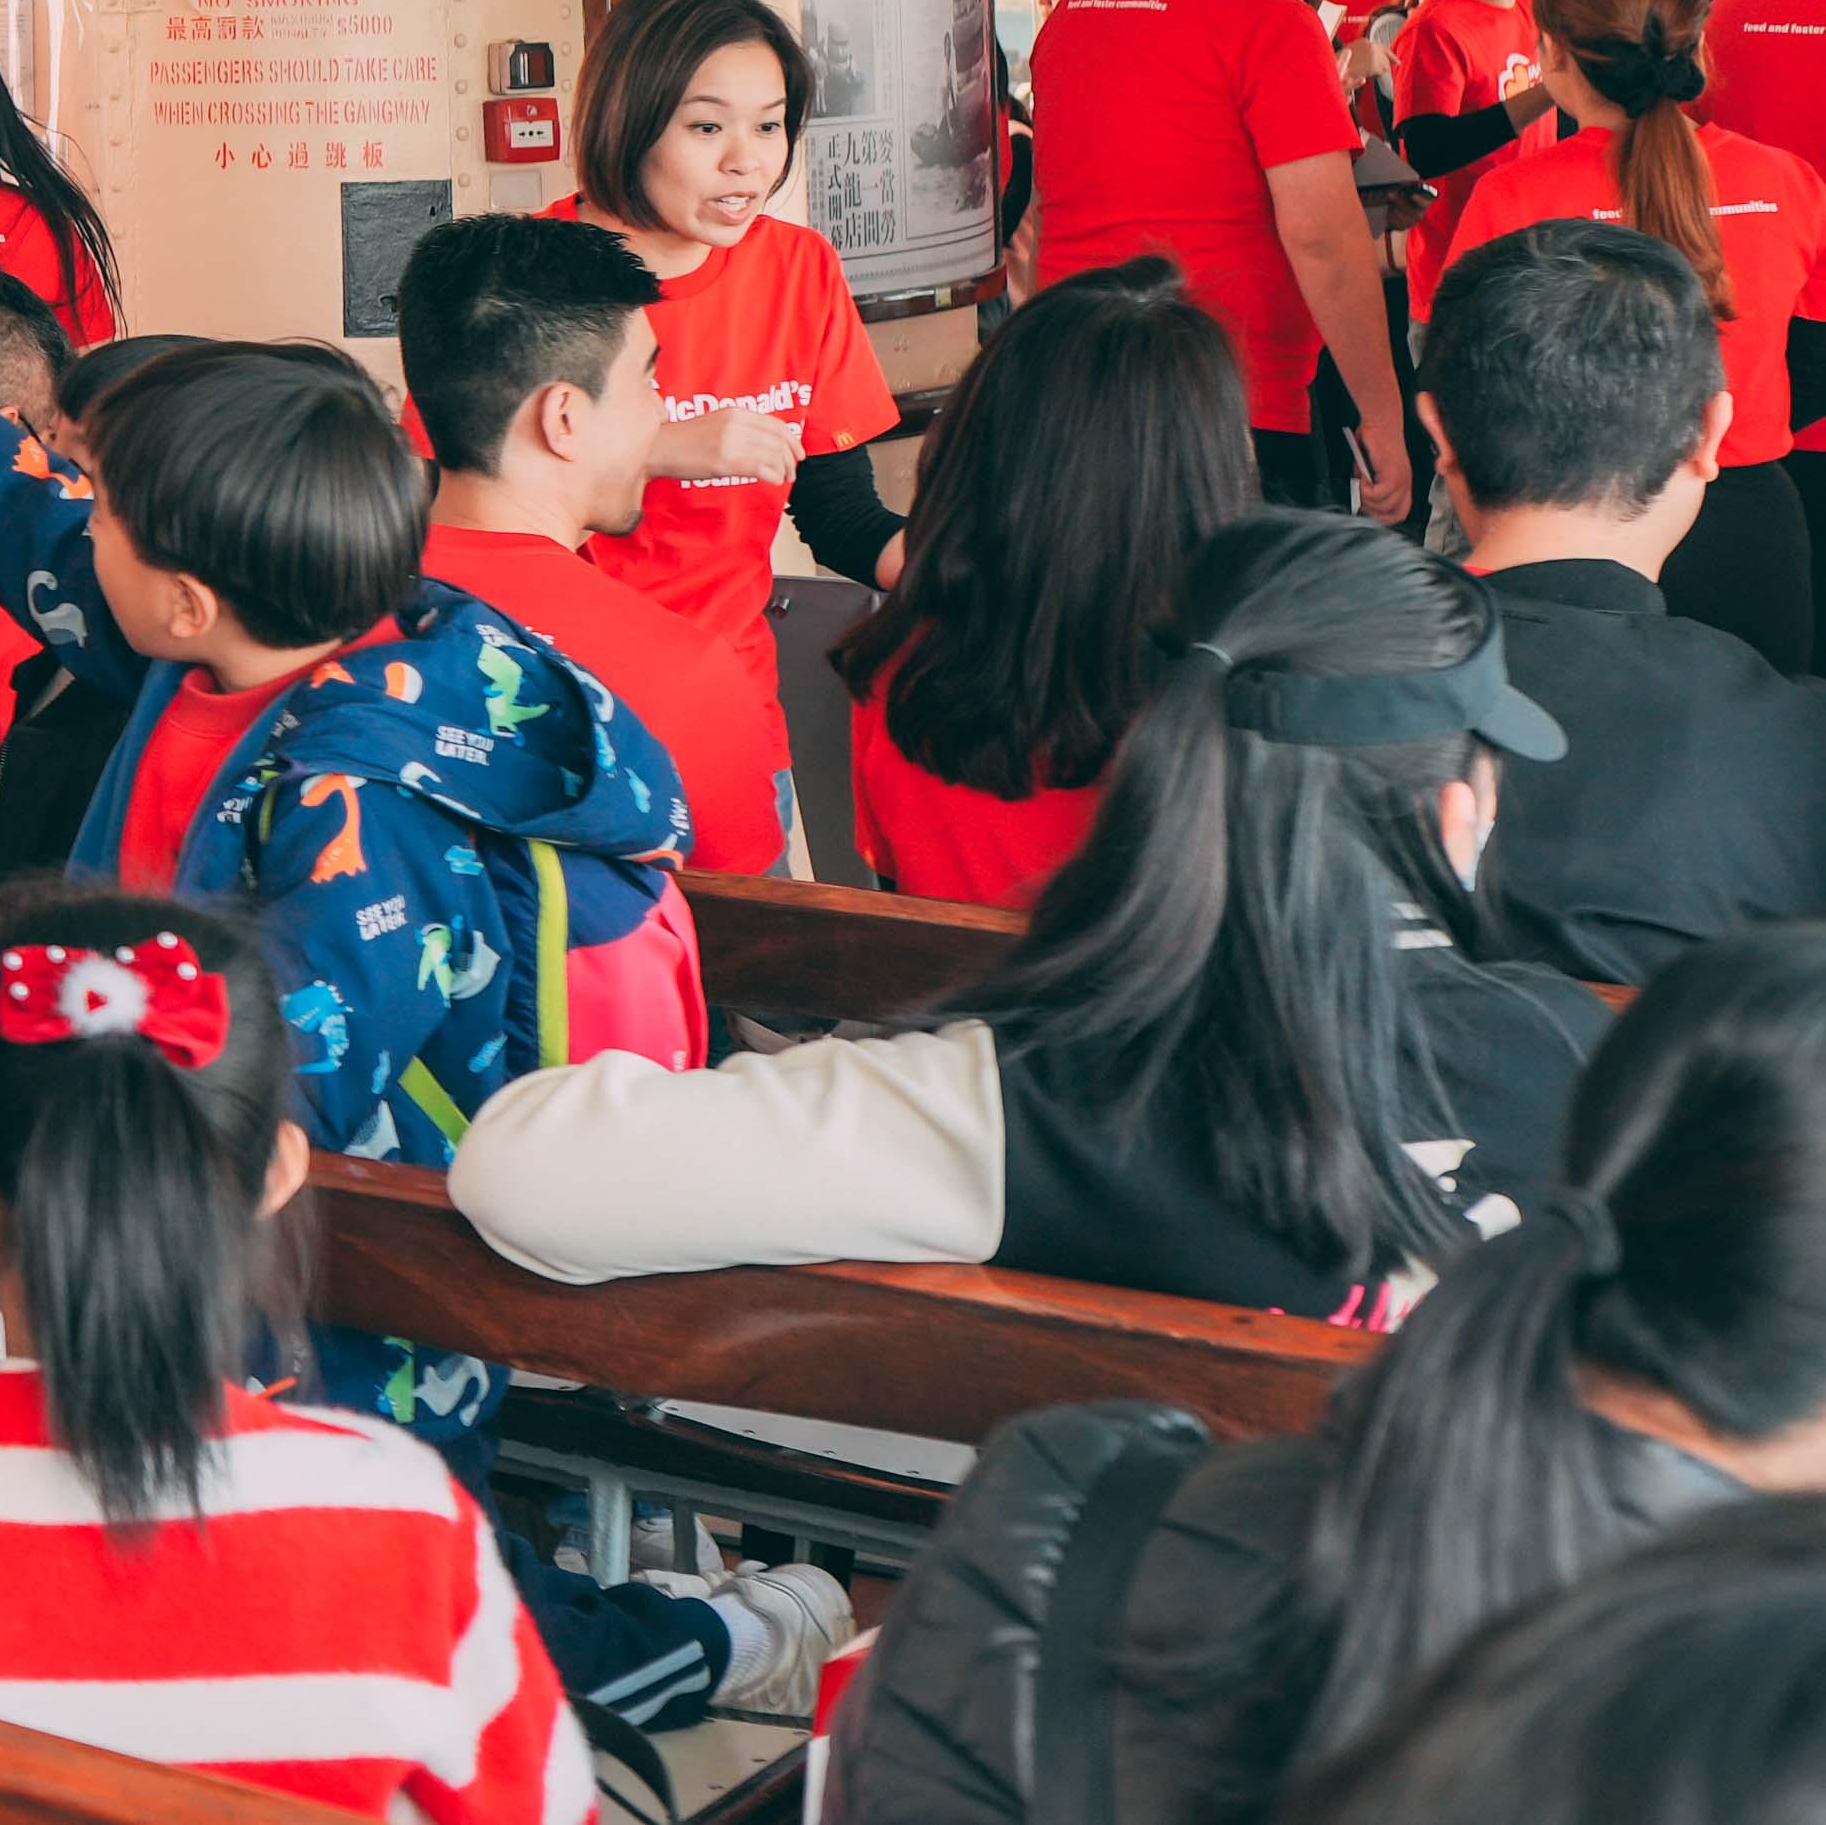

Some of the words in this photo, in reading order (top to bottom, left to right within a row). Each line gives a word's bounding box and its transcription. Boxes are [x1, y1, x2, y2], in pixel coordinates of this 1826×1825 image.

[149, 60, 264, 85] PASSENGERS
[269, 58, 339, 84] SHOULD
[345, 57, 388, 83] TAKE
[392, 56, 438, 81] CARE
[153, 100, 204, 126] WHEN
[207, 100, 300, 126] CROSSING
[305, 99, 339, 125] THE
[343, 98, 430, 125] GANGWAY
[1709, 199, 1778, 216] mmunities
